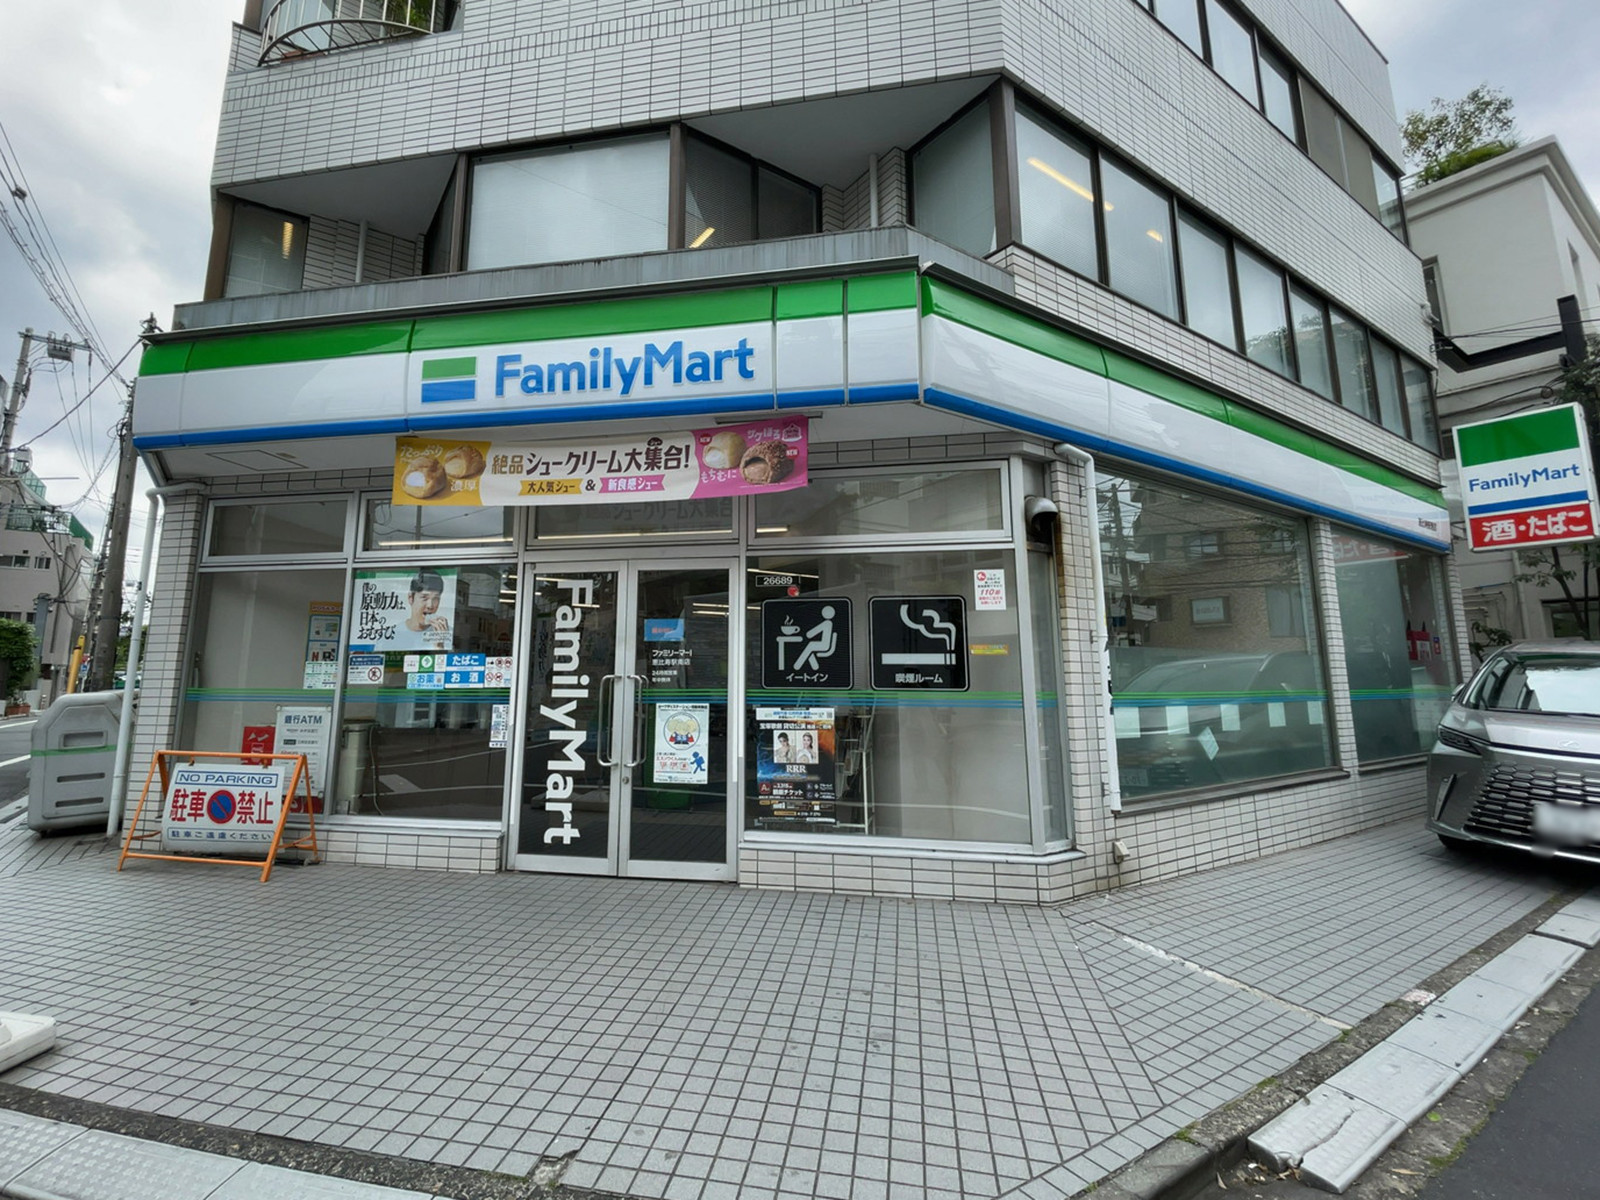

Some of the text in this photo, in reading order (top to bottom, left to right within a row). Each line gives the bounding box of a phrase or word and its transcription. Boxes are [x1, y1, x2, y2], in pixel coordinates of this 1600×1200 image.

[495, 337, 754, 396] FamilyMart
[400, 444, 443, 458] たっぷり
[1468, 464, 1581, 493] FamilyMart
[527, 478, 658, 493] 大人気シュー & 新食感シュー
[1481, 510, 1588, 542] 酒・たばこ
[763, 576, 793, 585] 26689
[359, 611, 386, 626] 日本の
[452, 655, 479, 666] たばこ
[785, 673, 828, 682] イートイン
[895, 673, 943, 683] 喫煙ルーム
[539, 579, 594, 845] FamilyMart
[284, 715, 323, 724] 銀行ATM
[786, 765, 807, 773] RRR
[179, 773, 273, 784] NO PARKING
[169, 788, 274, 825] 駐車 禁止
[171, 830, 272, 841] 駐車ご遠慮ください
